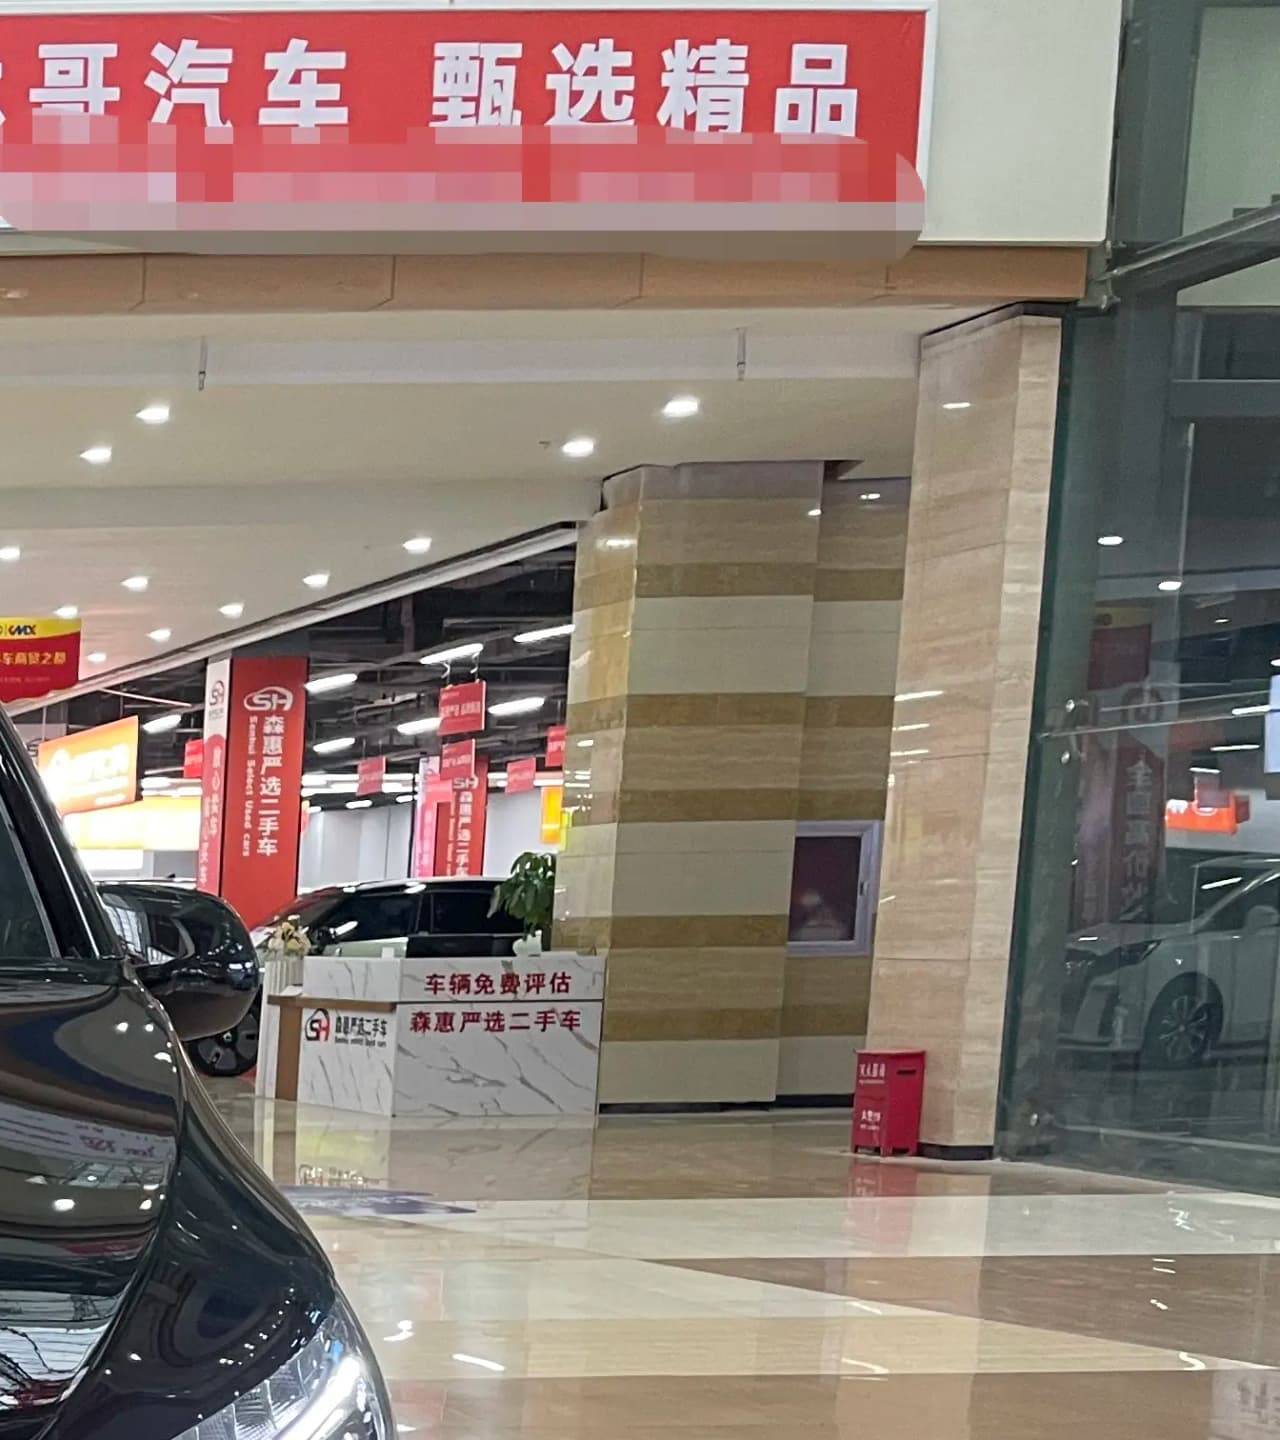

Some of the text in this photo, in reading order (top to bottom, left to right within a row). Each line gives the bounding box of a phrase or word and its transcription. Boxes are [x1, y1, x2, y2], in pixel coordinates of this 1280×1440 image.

[428, 37, 858, 138] 甄选精品
[256, 715, 285, 857] 森惠严选二手车
[424, 972, 573, 995] 车辆免费评估
[409, 1009, 582, 1034] 森惠严选二手车
